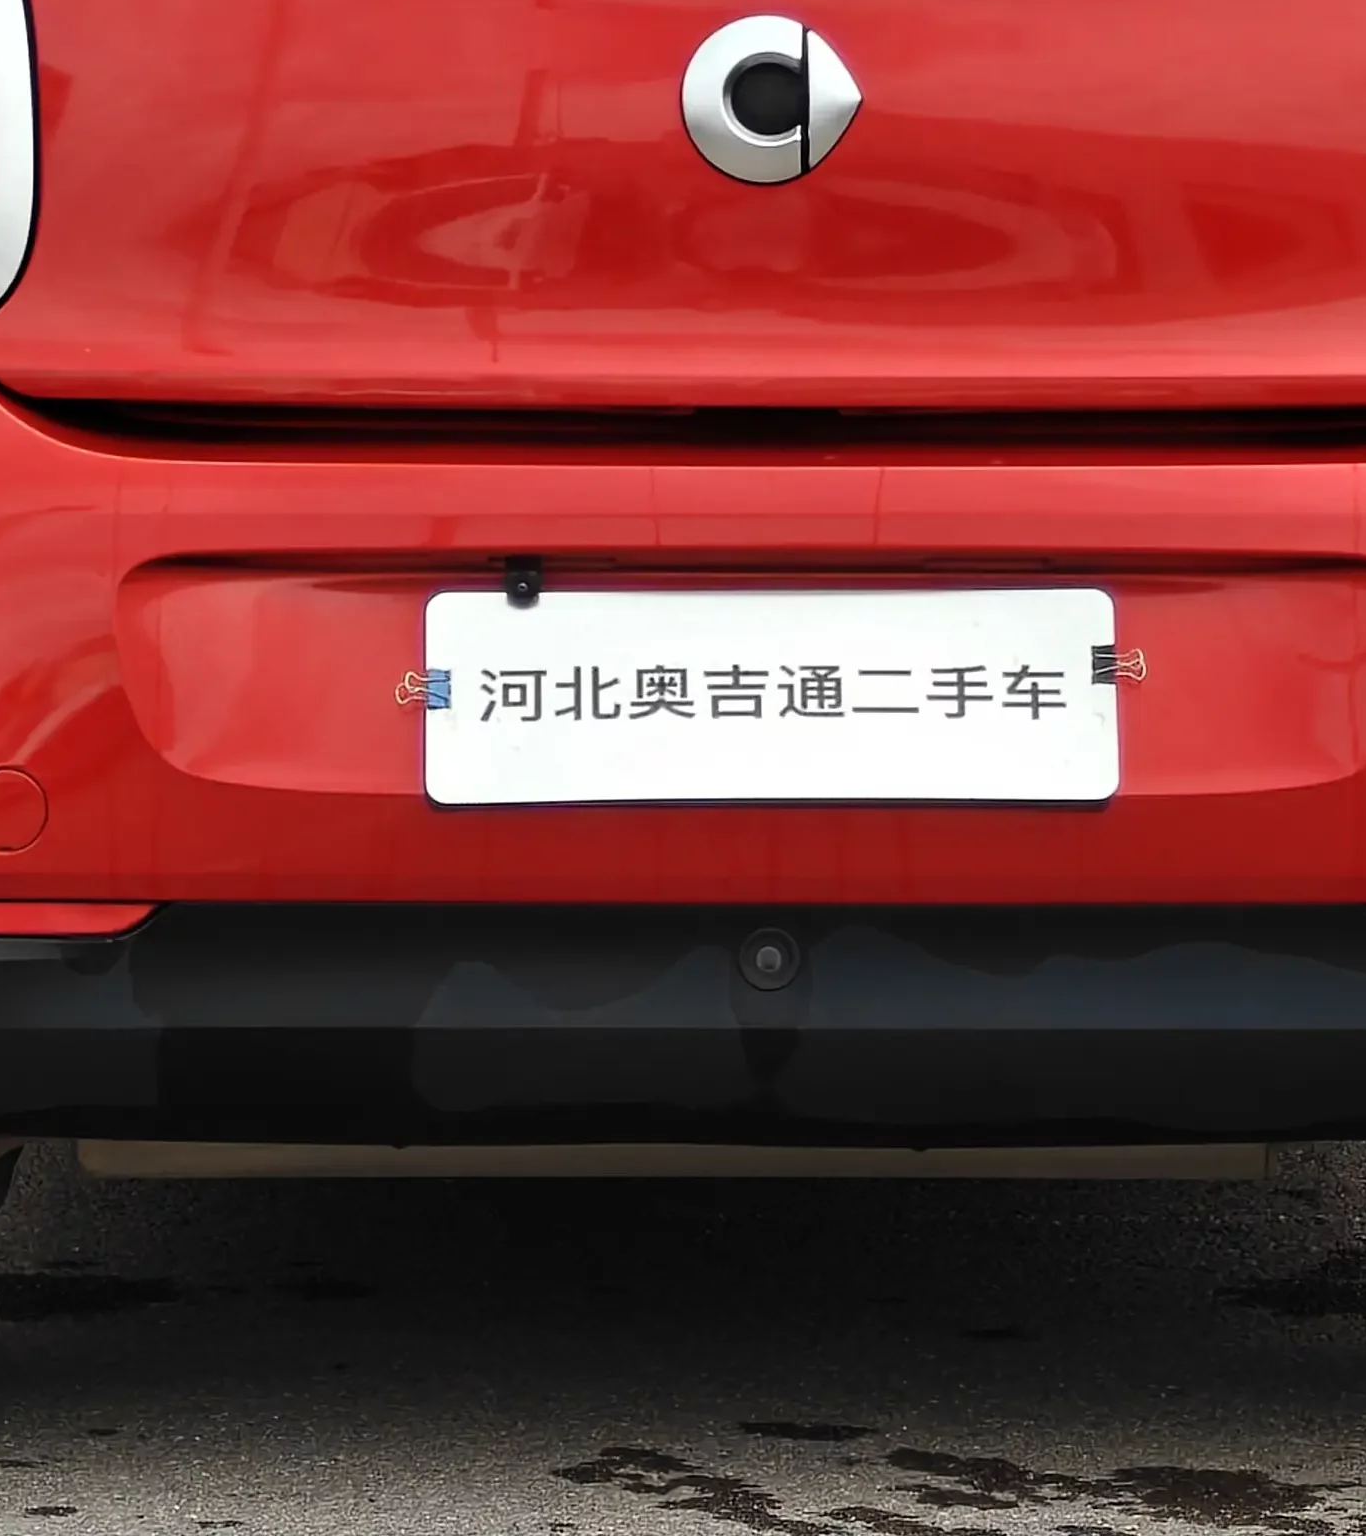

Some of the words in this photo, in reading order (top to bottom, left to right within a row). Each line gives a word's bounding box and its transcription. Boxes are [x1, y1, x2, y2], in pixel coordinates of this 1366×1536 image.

[478, 663, 1069, 723] 河北奥吉通二手车
